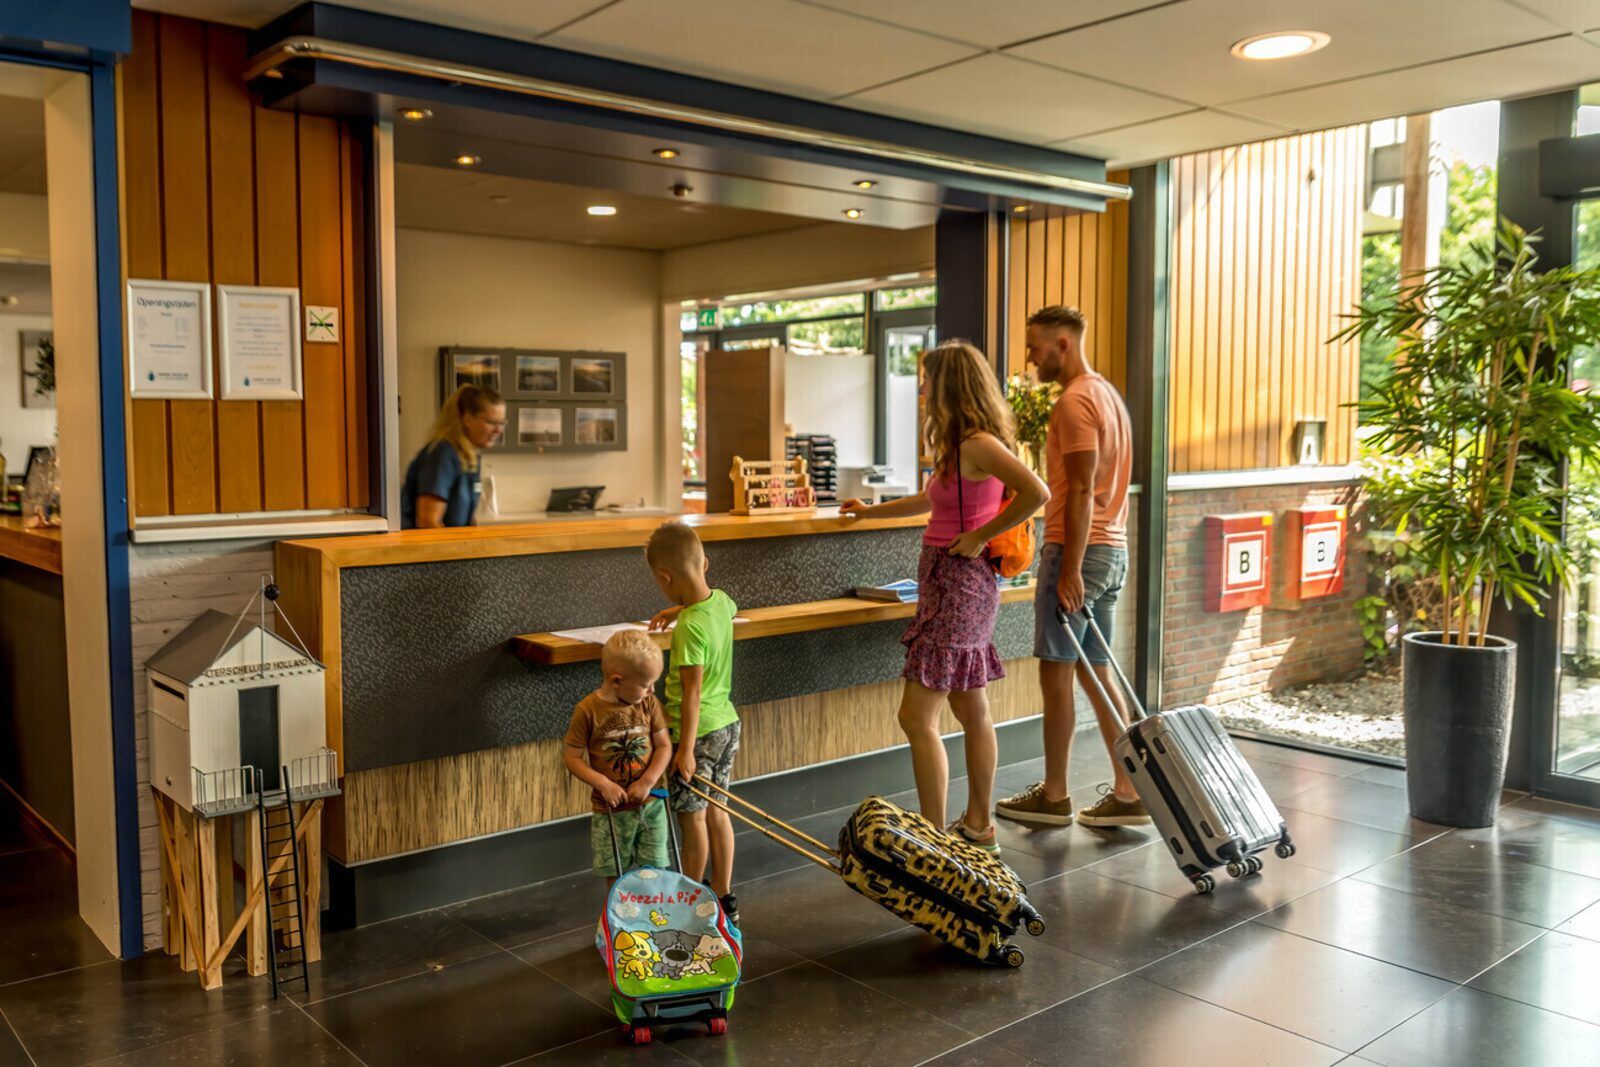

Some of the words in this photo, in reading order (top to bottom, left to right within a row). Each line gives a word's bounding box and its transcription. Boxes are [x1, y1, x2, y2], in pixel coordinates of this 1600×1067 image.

[1240, 551, 1250, 574] B
[272, 658, 309, 671] HOLLAND
[618, 890, 664, 905] Woezel
[677, 890, 698, 906] Pip
